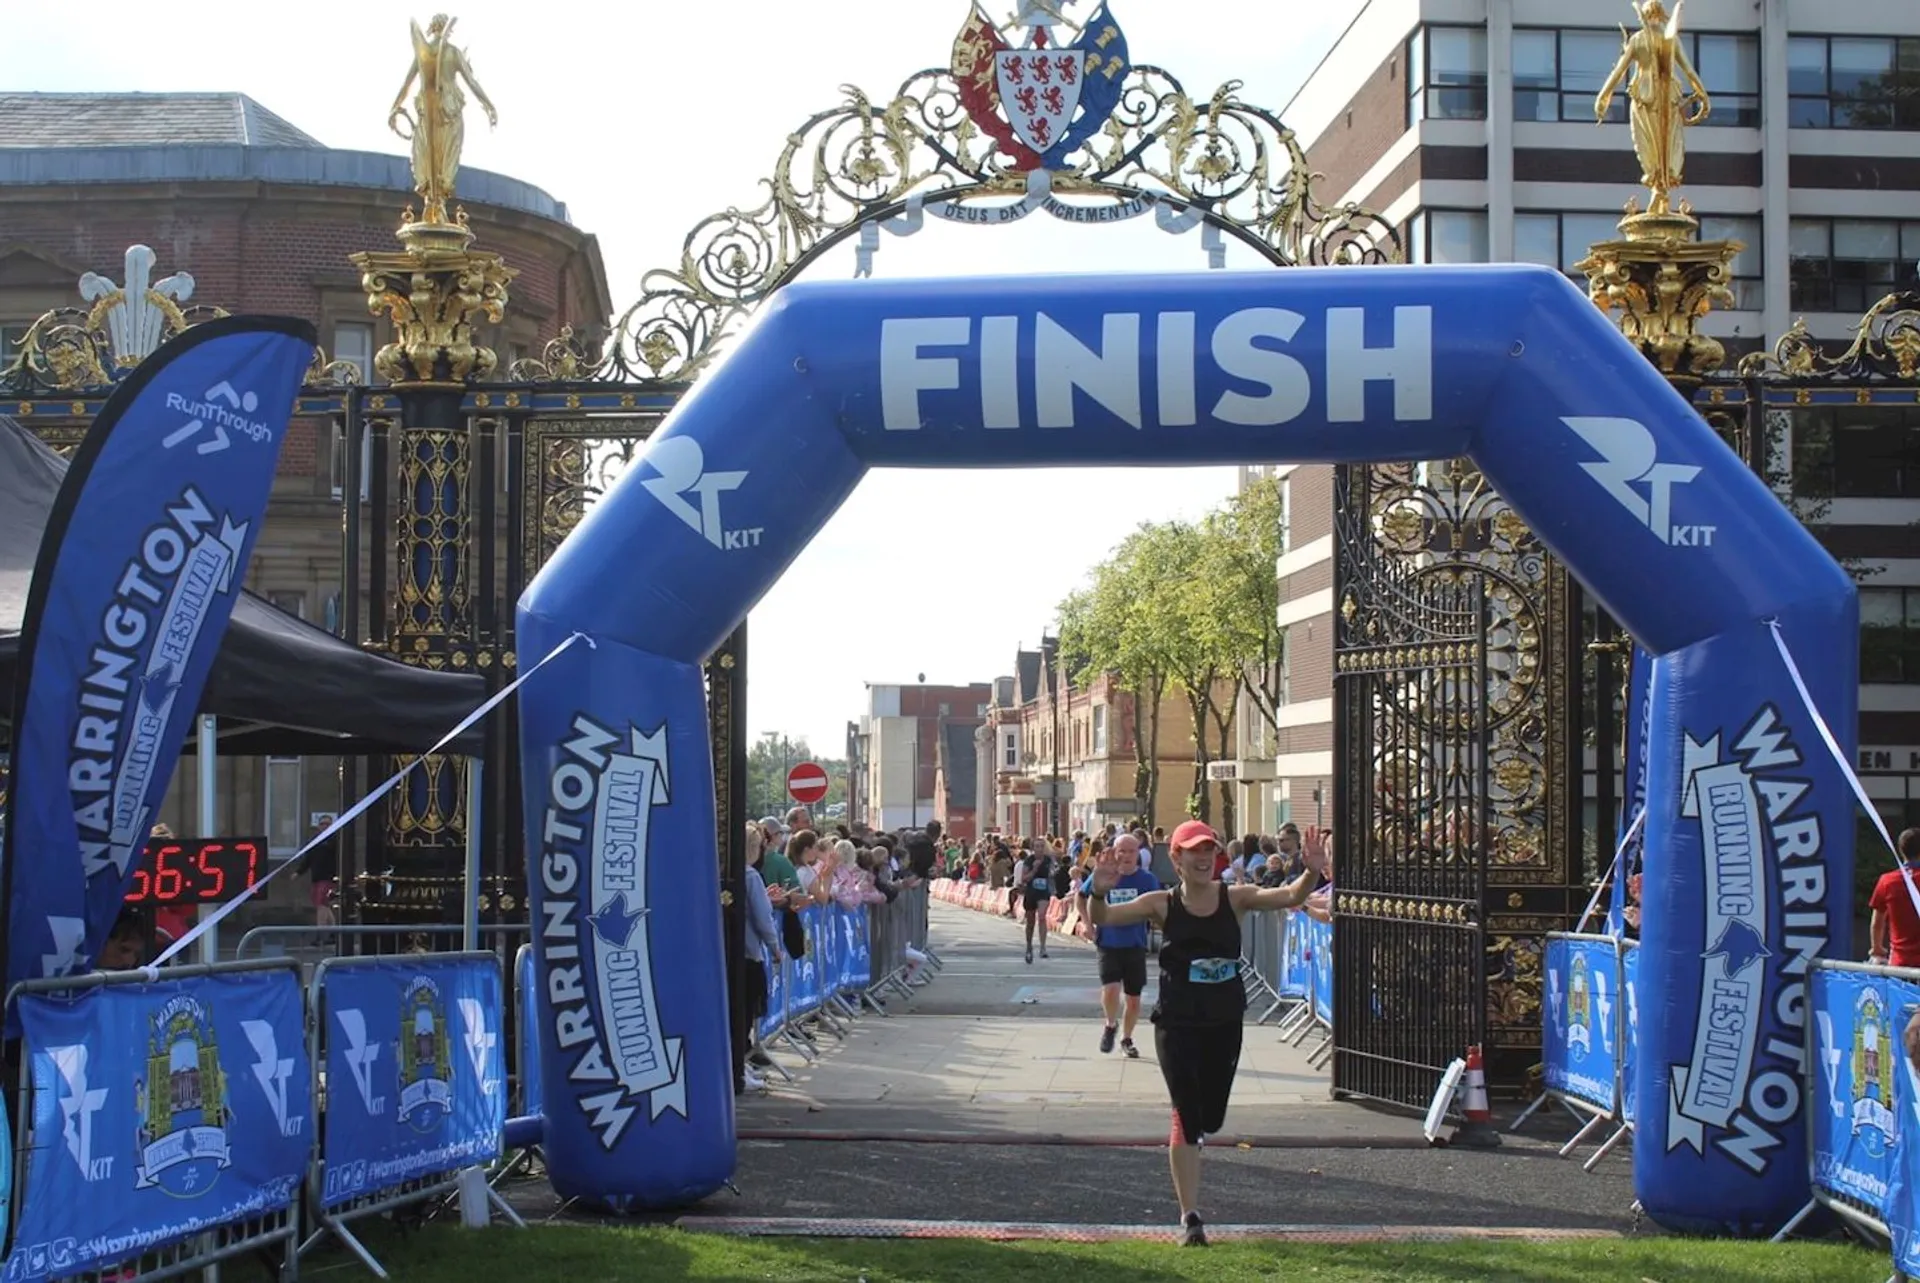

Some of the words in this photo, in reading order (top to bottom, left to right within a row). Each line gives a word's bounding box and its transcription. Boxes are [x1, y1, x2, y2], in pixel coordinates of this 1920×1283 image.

[943, 203, 988, 222] DEUS
[1000, 199, 1028, 221] DAT
[165, 391, 273, 443] RunThrough
[880, 305, 1432, 430] FINISH
[724, 527, 764, 551] KIT
[1671, 525, 1717, 547] KIT
[160, 548, 222, 665] FESTIVAL
[603, 768, 644, 892] FESTIVAL
[1708, 782, 1754, 917] RUNNING
[543, 715, 636, 1150] WARRINGTON
[1715, 706, 1828, 1173] WARRINGTON
[605, 949, 657, 1079] RUNNING
[1695, 978, 1750, 1109] FESTIVAL
[285, 1115, 304, 1137] KIT
[369, 1095, 386, 1116] KIT
[89, 1156, 115, 1181] KIT
